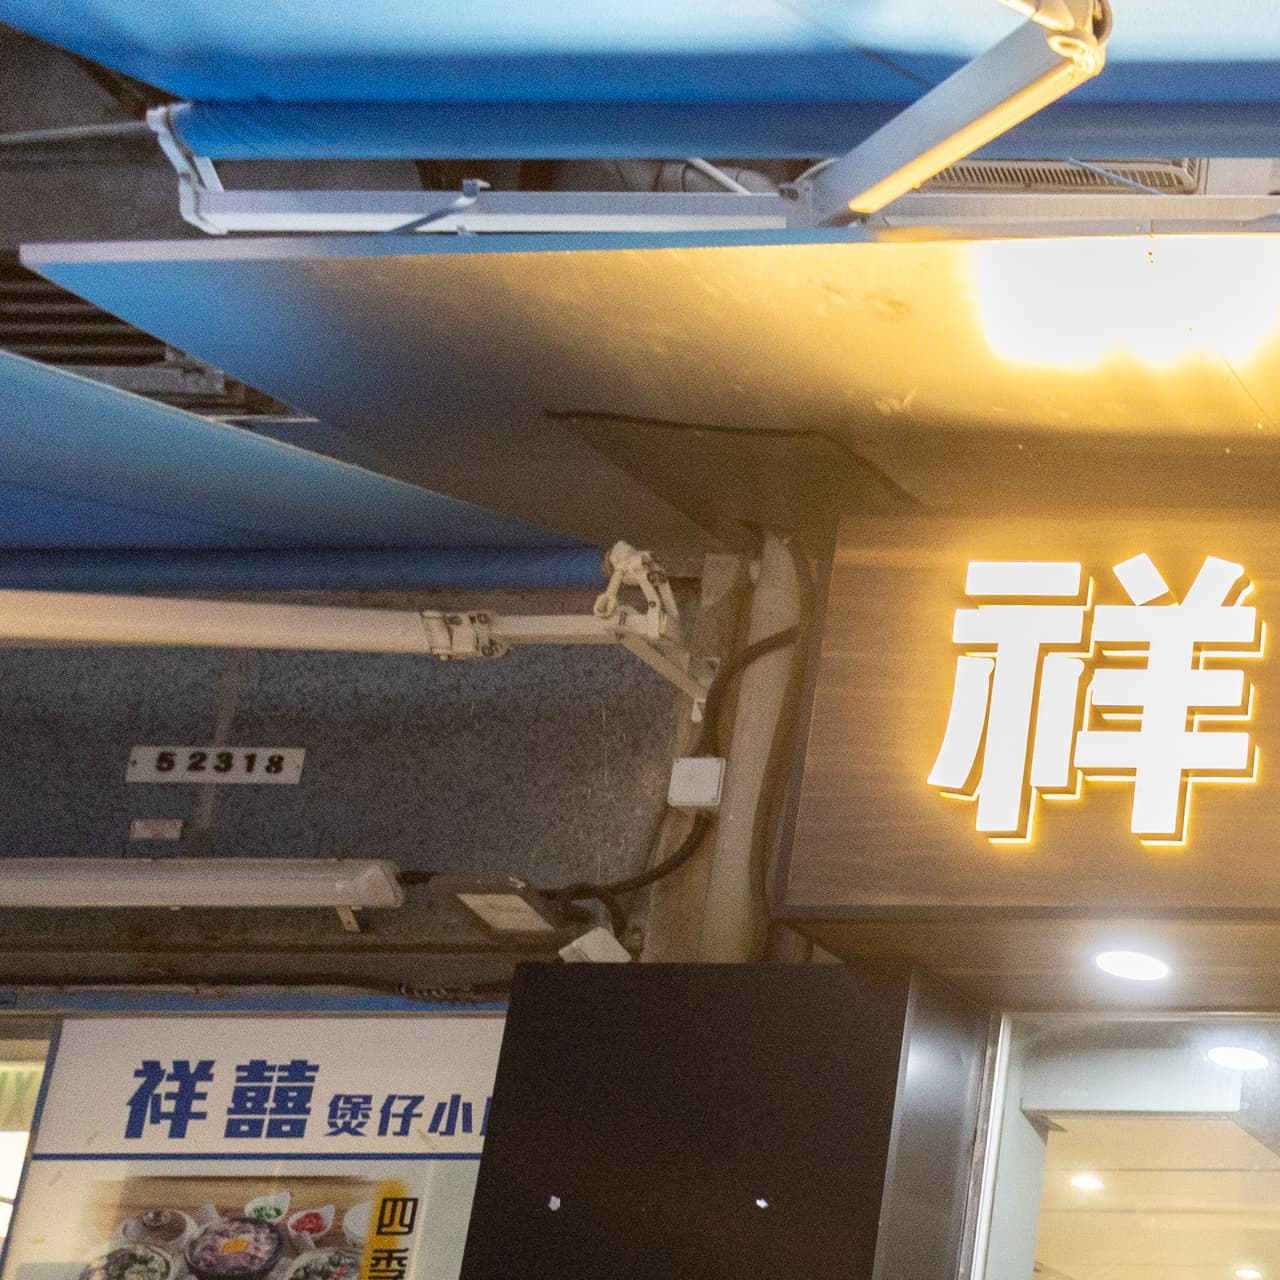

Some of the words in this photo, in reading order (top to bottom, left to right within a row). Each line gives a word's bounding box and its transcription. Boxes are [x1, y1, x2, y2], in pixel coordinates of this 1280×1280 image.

[155, 751, 284, 774] 52318
[124, 1059, 320, 1140] 祥囍
[324, 1093, 491, 1138] 煲仔小
